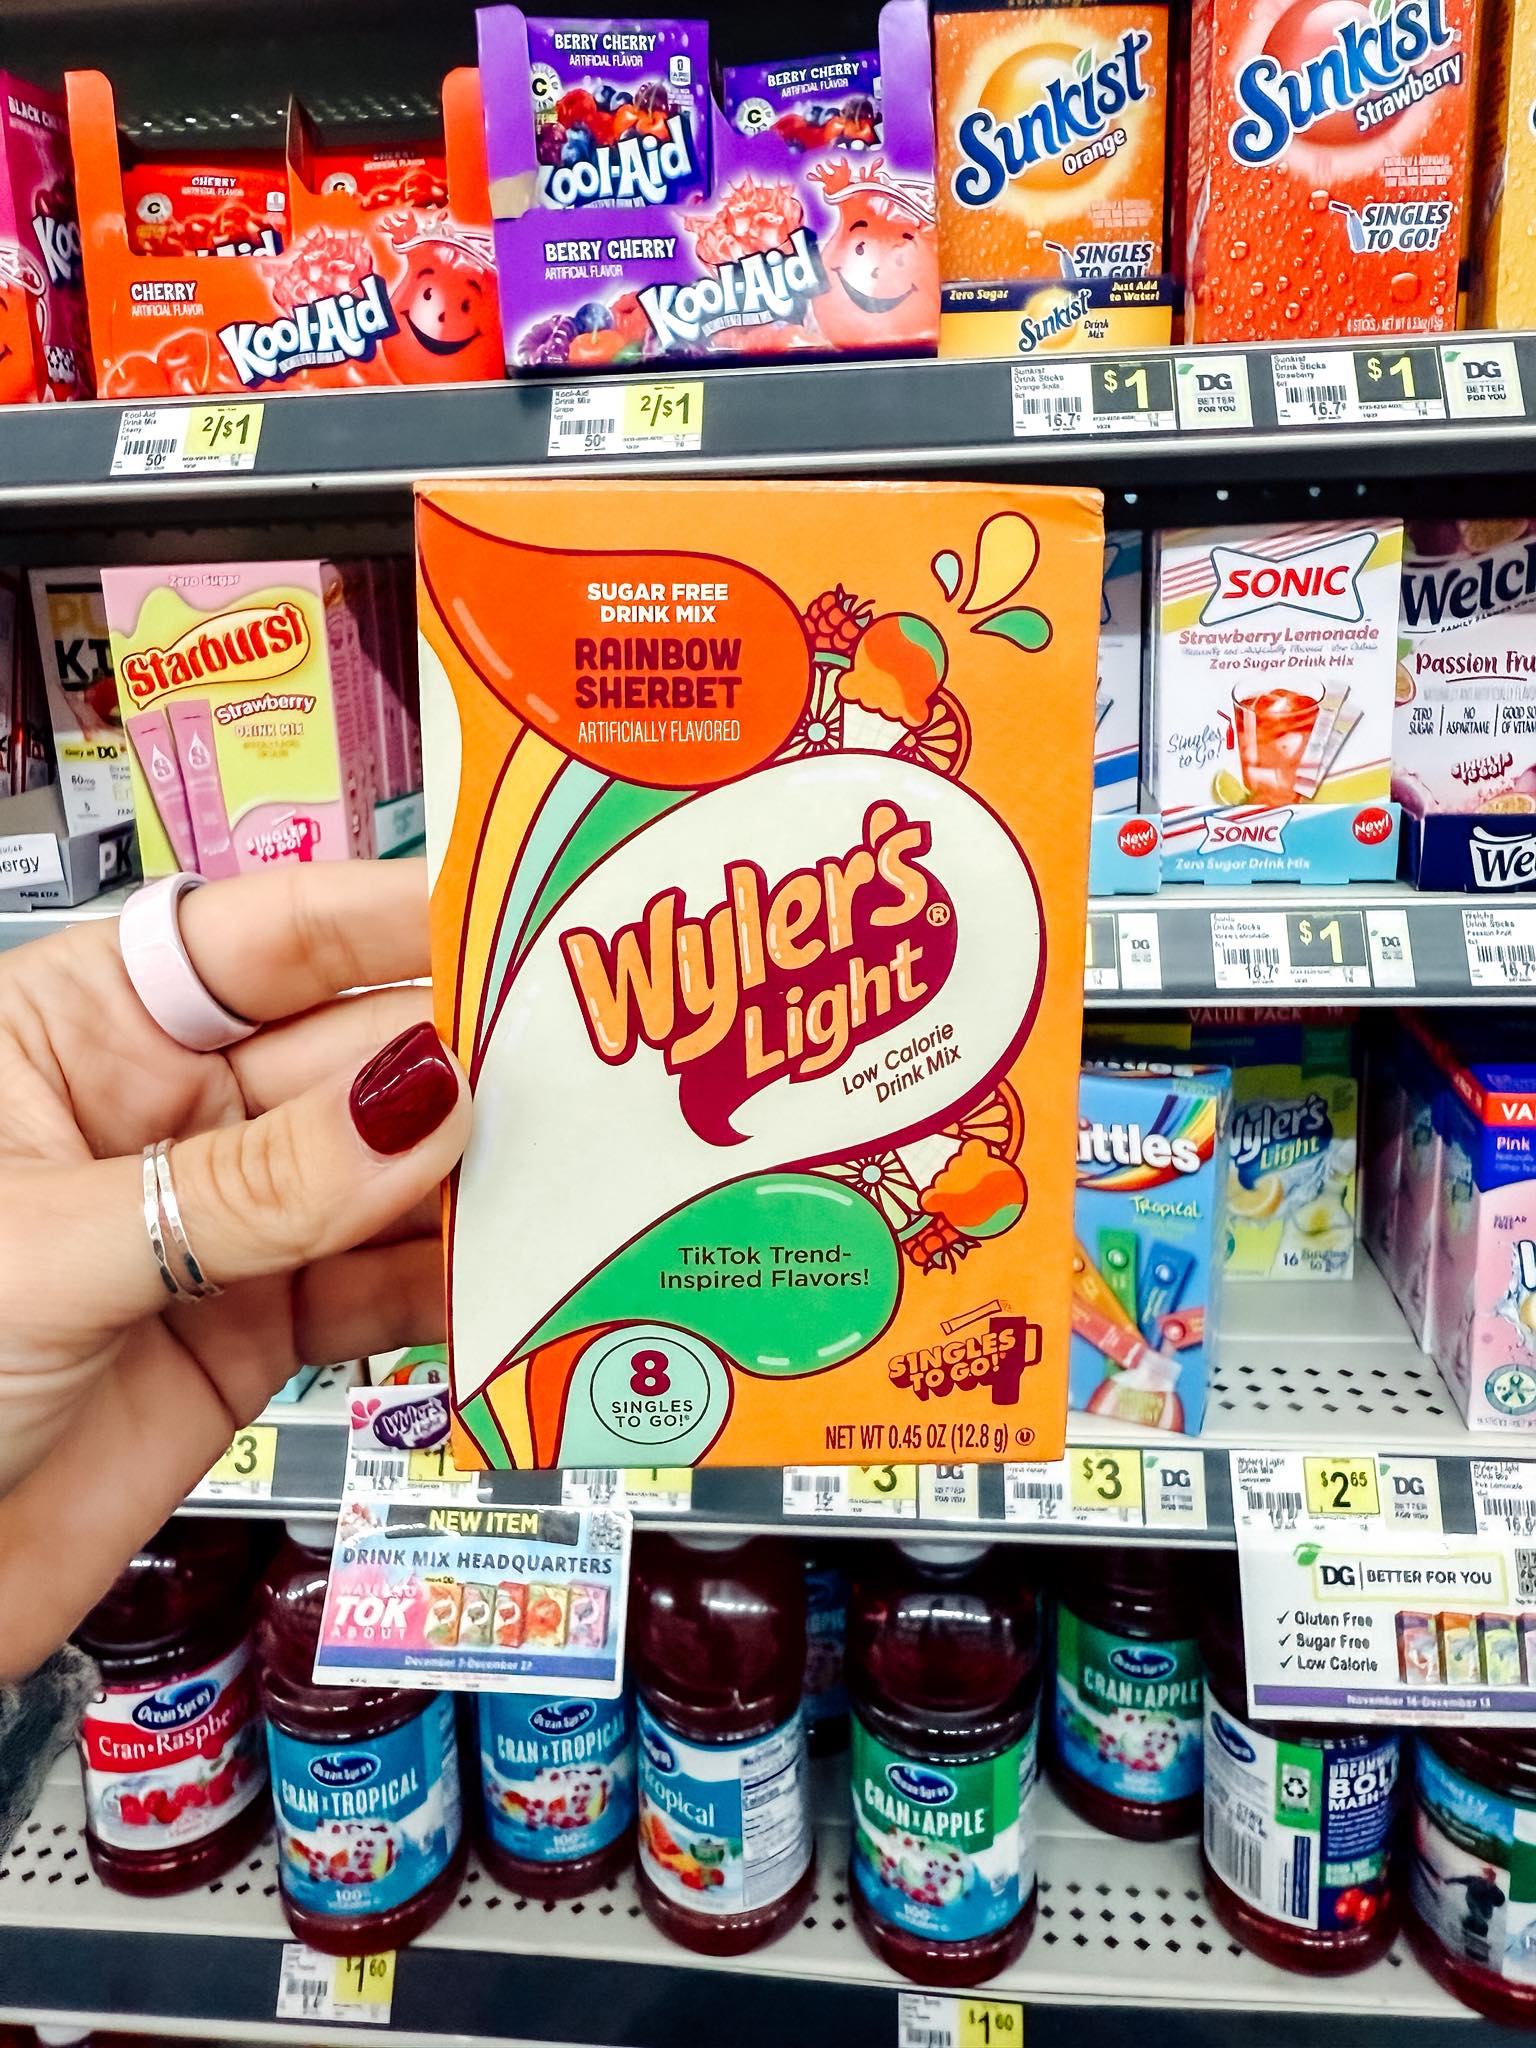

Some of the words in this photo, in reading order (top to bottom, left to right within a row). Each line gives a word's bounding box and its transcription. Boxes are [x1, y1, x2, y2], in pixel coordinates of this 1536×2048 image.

[555, 33, 598, 51] BERRY
[603, 34, 656, 52] CHERRY
[569, 54, 610, 66] ARTIFICIAL
[612, 54, 643, 67] FLAVOR
[767, 68, 807, 87] BERRY
[810, 62, 860, 81] CHERRY
[1233, 0, 1450, 163] Sunkist
[1357, 53, 1462, 132] Strawberry
[955, 32, 1149, 206] Sunkist
[1063, 128, 1127, 175] Orange
[192, 176, 236, 187] CHERRY
[1363, 204, 1450, 226] SINGLES
[545, 241, 602, 263] BERRY
[607, 238, 676, 260] CHERRY
[1368, 229, 1391, 249] TO
[1398, 228, 1438, 249] GO!
[1074, 243, 1152, 264] SINGLES
[545, 267, 589, 280] ARTIFICIAL
[590, 265, 622, 278] FLAVOR
[131, 282, 195, 301] CHERRY
[640, 230, 818, 346] Kool-Aid
[950, 290, 973, 300] Zero
[977, 289, 1008, 301] Sugar
[1110, 293, 1122, 301] to
[1124, 291, 1159, 301] Water!
[1112, 282, 1134, 291] Just
[1136, 281, 1158, 290] Add
[221, 276, 391, 385] Kool-Aid
[1018, 289, 1091, 351] Sunkist
[1367, 356, 1416, 398] $1
[1463, 360, 1502, 379] DG
[1103, 369, 1149, 409] $1
[1195, 372, 1233, 392] DG
[1466, 384, 1505, 394] BETTER
[1198, 405, 1216, 413] FOR
[1217, 404, 1236, 413] YOU
[1467, 394, 1486, 402] FOR
[1488, 392, 1507, 401] YOU
[587, 583, 666, 601] SUGAR
[672, 583, 729, 601] FREE
[1222, 565, 1349, 599] SONIC
[601, 605, 671, 623] DRINK
[676, 605, 717, 623] MIX
[1179, 628, 1282, 647] Strawberry
[1285, 625, 1380, 642] Lemonade
[123, 605, 305, 697] Starburst
[575, 637, 742, 671] RAINBOW
[1210, 658, 1240, 670] Zero
[1243, 656, 1286, 672] Sugar
[1288, 655, 1326, 668] Drink
[1329, 654, 1354, 667] Mix
[1416, 652, 1498, 676] Passion
[575, 676, 743, 709] SHERBET
[216, 693, 315, 724] Strawberry
[578, 721, 668, 744] ARTIFICIALLY
[670, 719, 741, 743] FLAVORED
[1120, 827, 1153, 847] New!
[1209, 824, 1278, 843] SONIC
[1354, 816, 1390, 837] New!
[1175, 858, 1205, 870] Zero
[1208, 857, 1248, 874] Sugar
[1249, 857, 1285, 870] Drink
[562, 803, 930, 1070] Wyler's
[1299, 919, 1344, 964] $1
[744, 938, 929, 1080] Light
[842, 1063, 879, 1096] Low
[884, 1023, 954, 1070] Calorie
[875, 1062, 925, 1103] Drink
[926, 1044, 962, 1076] Mix
[1077, 1117, 1200, 1173] ittles
[1261, 1136, 1320, 1170] Light
[1496, 1136, 1531, 1151] Pink
[1130, 1195, 1201, 1218] Tropical
[678, 1246, 761, 1266] TikTok
[769, 1245, 852, 1264] Trend-
[1283, 1252, 1298, 1267] 16
[660, 1270, 762, 1292] Inspired
[771, 1268, 870, 1289] Flavors!
[888, 1329, 1016, 1379] SINGLES
[630, 1349, 671, 1397] 8
[910, 1368, 945, 1392] TO
[950, 1353, 1000, 1382] GO!
[611, 1399, 693, 1414] SINGLES
[615, 1415, 641, 1428] TO
[825, 1425, 856, 1449] NET
[860, 1425, 885, 1449] WT
[888, 1424, 922, 1449] 0.45
[926, 1423, 947, 1449] OZ
[951, 1423, 989, 1453] (12.8
[994, 1423, 1009, 1453] g)
[1082, 1457, 1123, 1500] $3
[1160, 1469, 1191, 1488] DG
[1393, 1476, 1425, 1496] DG
[429, 1509, 485, 1533] NEW
[486, 1511, 539, 1534] ITEM
[342, 1548, 405, 1568] DRINK
[412, 1551, 450, 1569] MIX
[457, 1552, 613, 1575] HEADQUARTERS
[1320, 1565, 1355, 1586] DG
[1367, 1569, 1422, 1584] BETTER
[1426, 1570, 1457, 1585] FOR
[1460, 1571, 1492, 1585] YOU
[334, 1596, 416, 1628] TOK
[1294, 1610, 1339, 1629] Gluten
[1343, 1612, 1373, 1628] Free
[1296, 1633, 1336, 1652] Sugar
[1340, 1634, 1370, 1649] Free
[1297, 1656, 1325, 1670] Low
[1330, 1655, 1378, 1672] Calorie
[1084, 1665, 1133, 1707] CRAN
[1144, 1679, 1199, 1709] APPLE
[497, 1733, 539, 1764] CRAN
[281, 1778, 319, 1815] CRAN
[331, 1767, 419, 1817] TROPICAL
[864, 1777, 911, 1829] CRAN
[921, 1808, 987, 1839] APPLE
